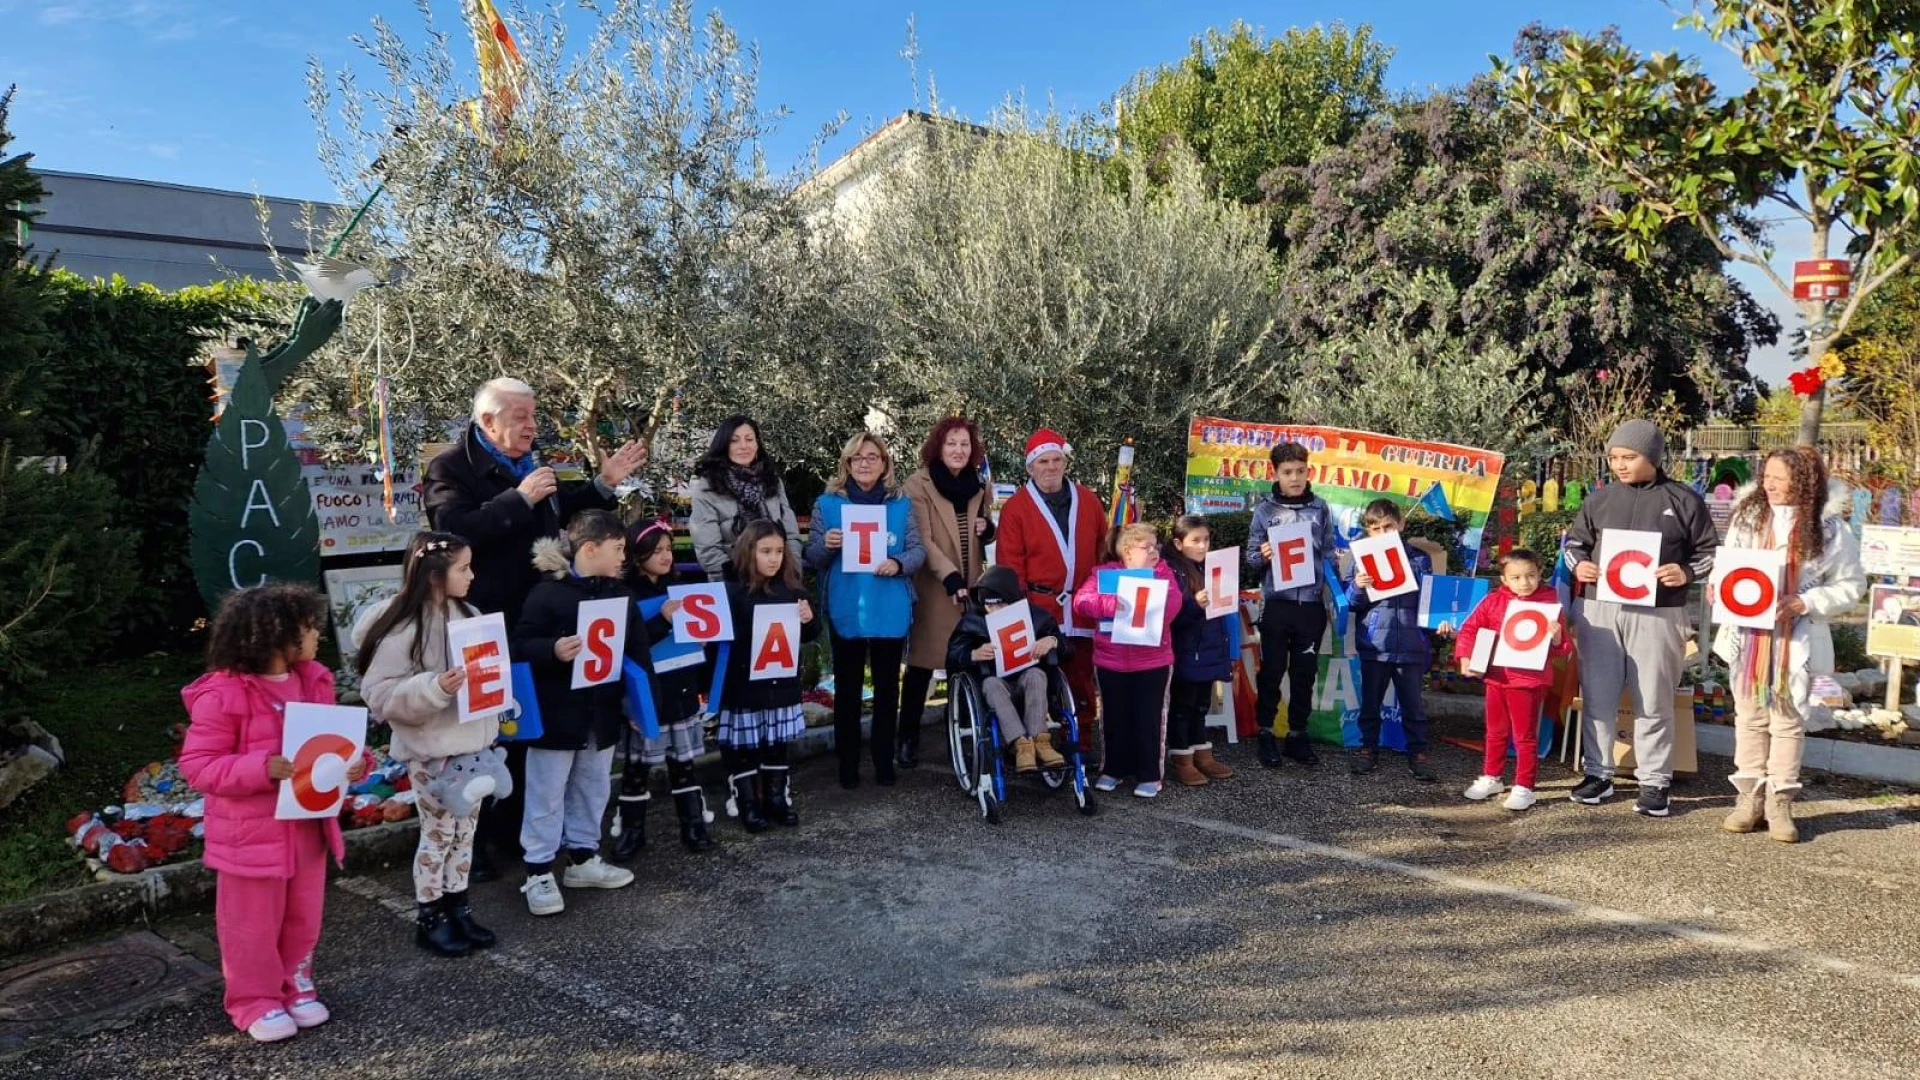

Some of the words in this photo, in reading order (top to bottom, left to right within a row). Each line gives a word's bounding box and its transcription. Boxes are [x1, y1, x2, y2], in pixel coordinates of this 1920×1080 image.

[1337, 437, 1368, 460] LA
[1380, 444, 1487, 478] GUERRA
[328, 475, 351, 486] UNA
[850, 522, 878, 564] T
[1278, 538, 1305, 581] F
[1212, 567, 1232, 608] L
[1361, 548, 1406, 591] U
[1606, 550, 1653, 600] C
[1132, 586, 1150, 628] I
[1720, 567, 1774, 617] O
[681, 594, 721, 639] S
[1504, 609, 1550, 651] O
[583, 618, 615, 682] S
[754, 622, 794, 671] A
[997, 619, 1033, 671] E
[462, 641, 505, 713] E
[291, 732, 357, 812] C
